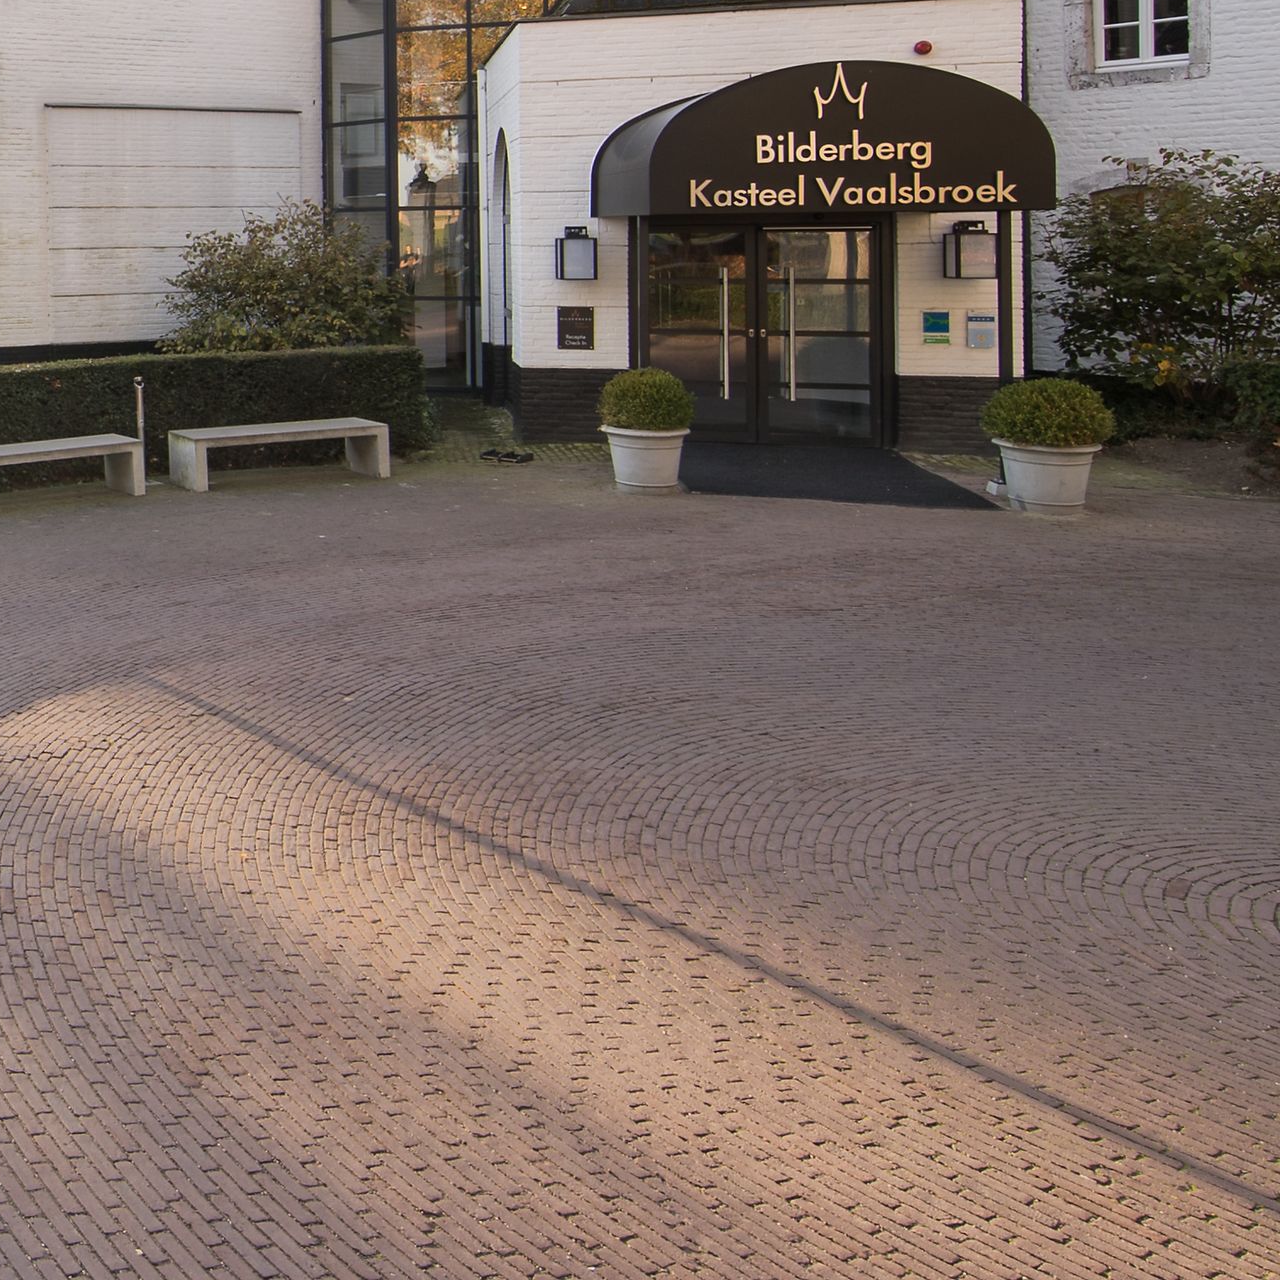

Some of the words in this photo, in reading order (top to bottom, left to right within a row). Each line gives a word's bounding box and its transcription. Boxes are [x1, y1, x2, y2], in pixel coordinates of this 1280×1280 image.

[756, 129, 932, 169] Bilderberg
[689, 174, 806, 208] Kasteel
[816, 170, 1018, 207] Vaalsbroek
